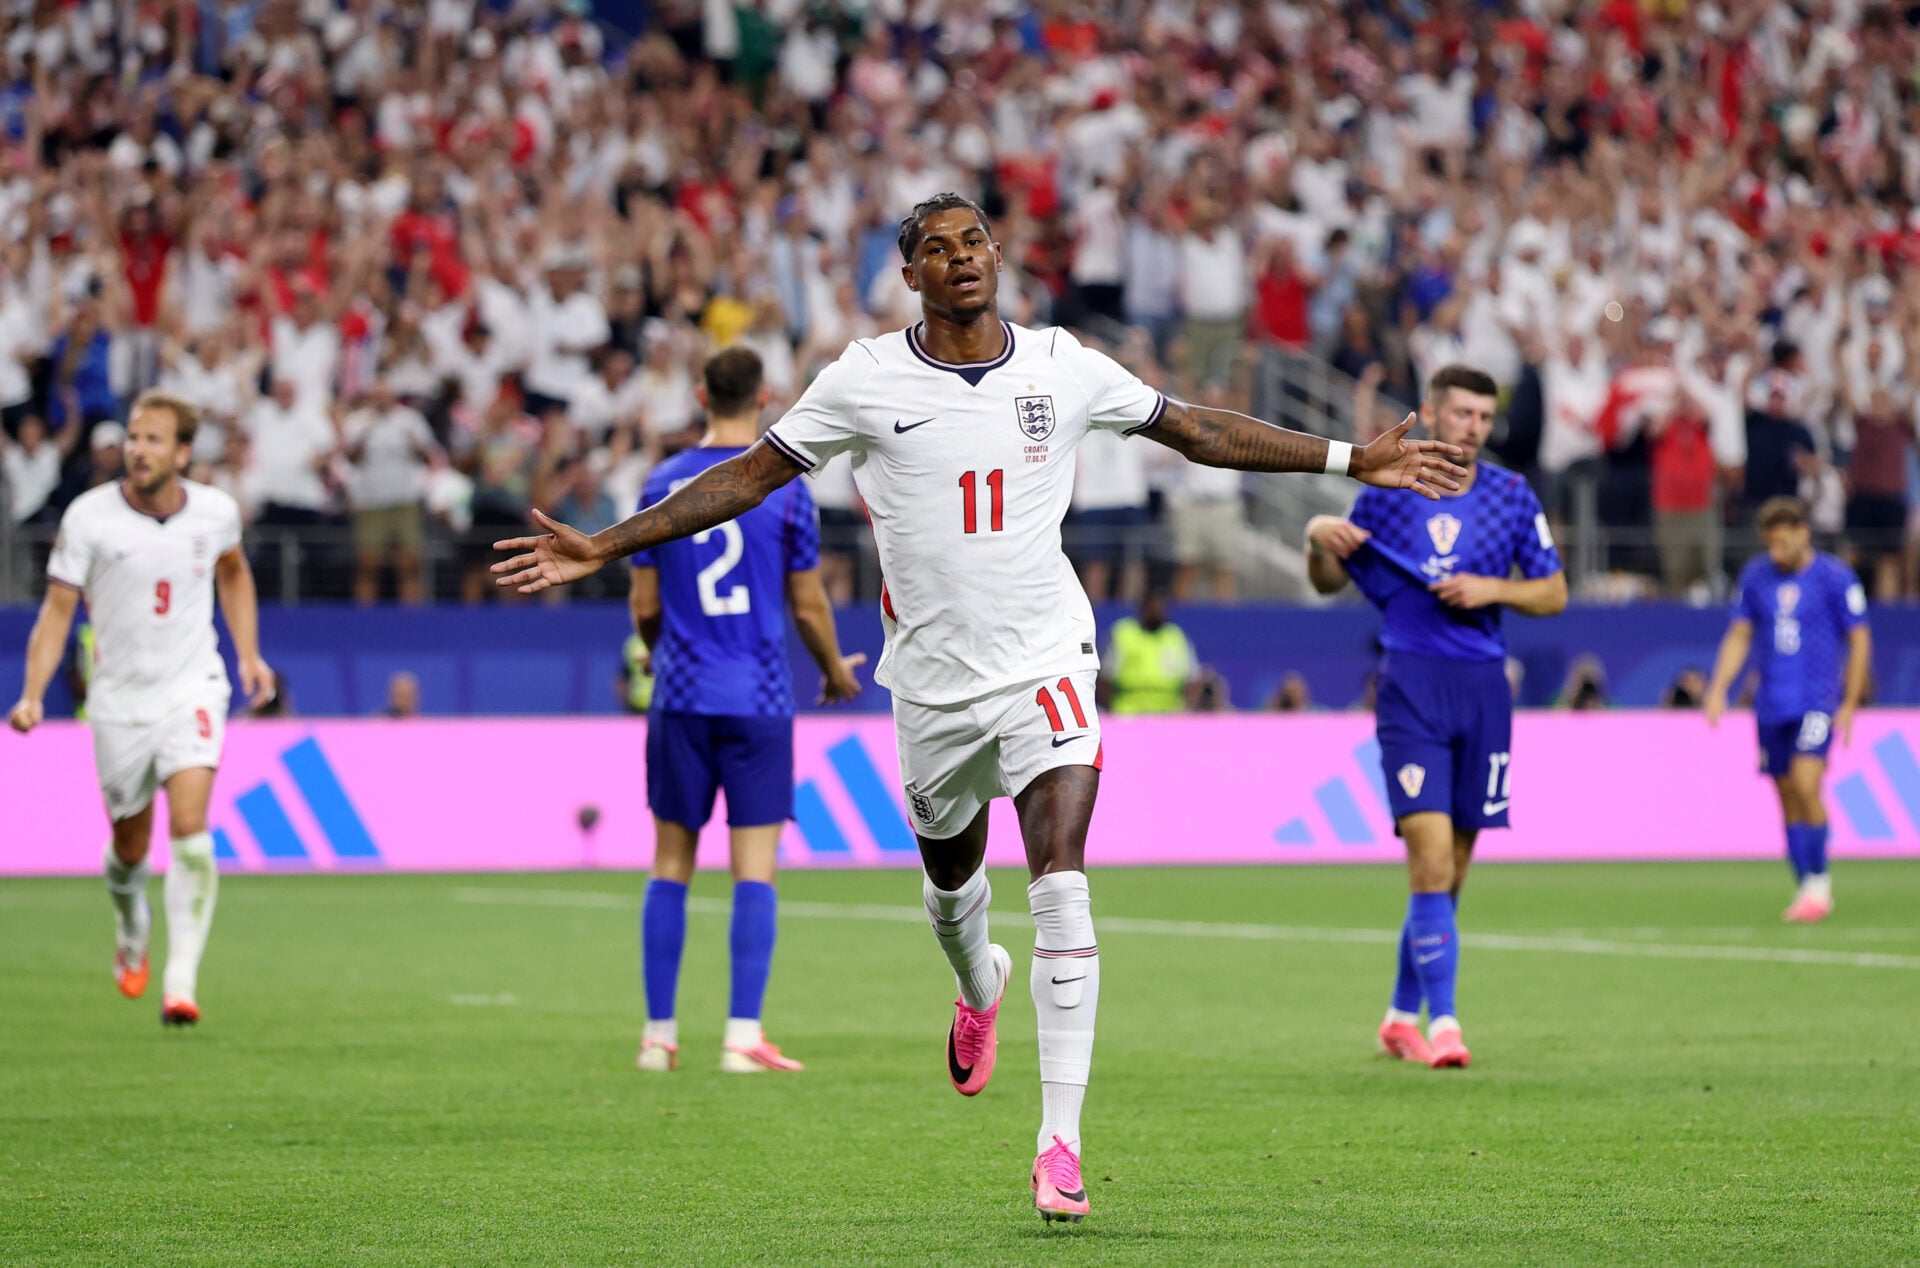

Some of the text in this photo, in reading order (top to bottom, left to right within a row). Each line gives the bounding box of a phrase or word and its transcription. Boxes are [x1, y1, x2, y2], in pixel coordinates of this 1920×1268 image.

[1024, 445, 1048, 453] CROATIA
[958, 468, 1004, 534] 11
[692, 518, 750, 617] 2
[153, 579, 172, 615] 9
[195, 707, 213, 740] 9
[1036, 676, 1089, 733] 11
